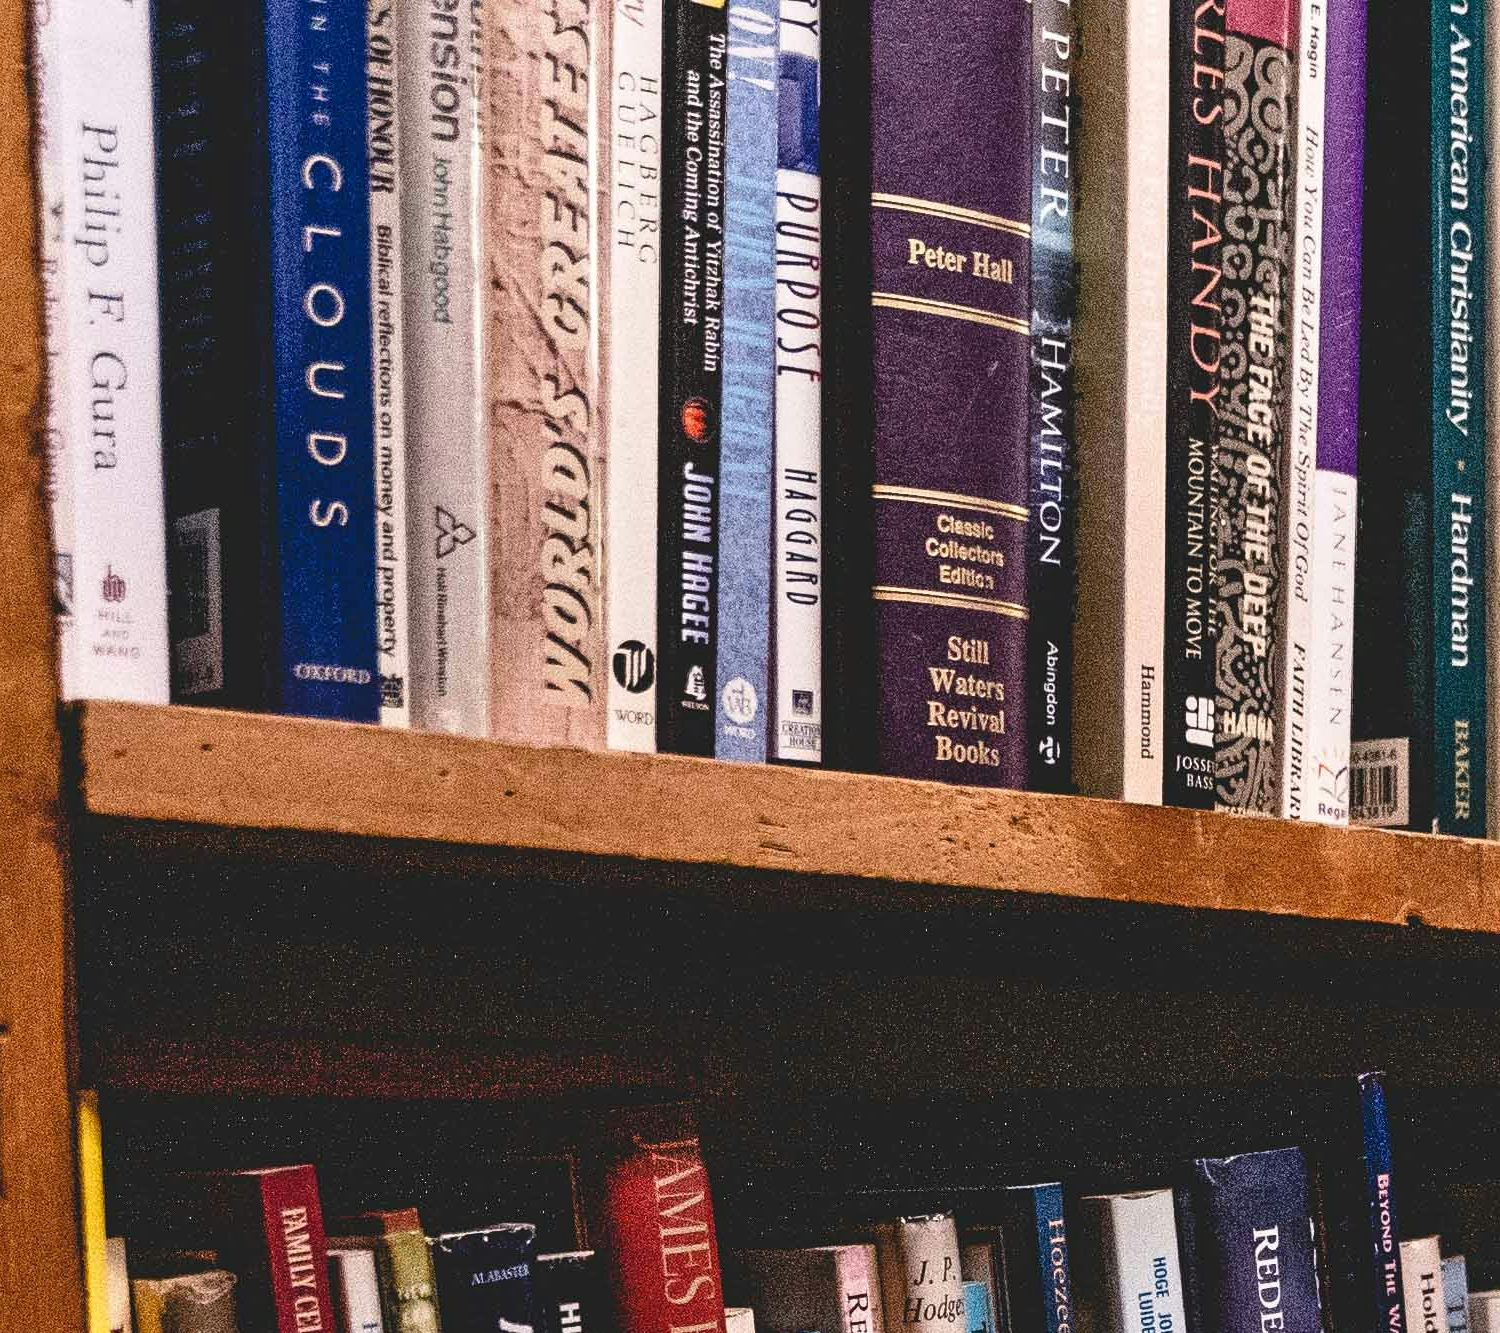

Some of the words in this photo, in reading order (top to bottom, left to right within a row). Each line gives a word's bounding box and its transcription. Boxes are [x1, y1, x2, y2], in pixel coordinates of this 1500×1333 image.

[708, 32, 725, 70] The
[685, 70, 703, 108] and
[1450, 25, 1472, 210] American
[685, 112, 701, 139] the
[705, 76, 724, 208] Assassination
[76, 122, 123, 268] Philip
[680, 146, 701, 219] Coming
[705, 212, 722, 233] of
[375, 224, 394, 294] Biblical
[682, 225, 701, 325] Antichrist
[703, 239, 722, 309] Yitzhak
[908, 238, 967, 273] Peter
[972, 250, 1014, 285] Hall
[86, 291, 125, 326] F.
[303, 153, 347, 528] CLOUDS
[702, 314, 721, 372] Rabin
[1446, 221, 1474, 435] Christianity
[376, 300, 396, 403] reflections
[89, 351, 128, 471] Gura
[380, 408, 394, 440] on
[375, 446, 396, 516] money
[1039, 337, 1066, 564] HAMILTON
[681, 462, 712, 541] JOHN
[936, 515, 994, 539] Classic
[381, 521, 398, 561] and
[925, 538, 1004, 566] Collectors
[376, 567, 400, 656] property
[681, 551, 711, 644] HAGEE
[938, 564, 994, 590] Edition
[1450, 492, 1473, 666] Hardman
[294, 664, 372, 684] OXFORD
[929, 667, 1004, 701] Waters
[947, 635, 990, 666] Still
[1043, 641, 1059, 725] Abingdon
[927, 701, 1005, 734] Revival
[1139, 665, 1154, 758] Hammond
[936, 737, 1000, 765] Books
[1455, 719, 1471, 820] BAKER
[281, 1207, 317, 1289] FAMILY
